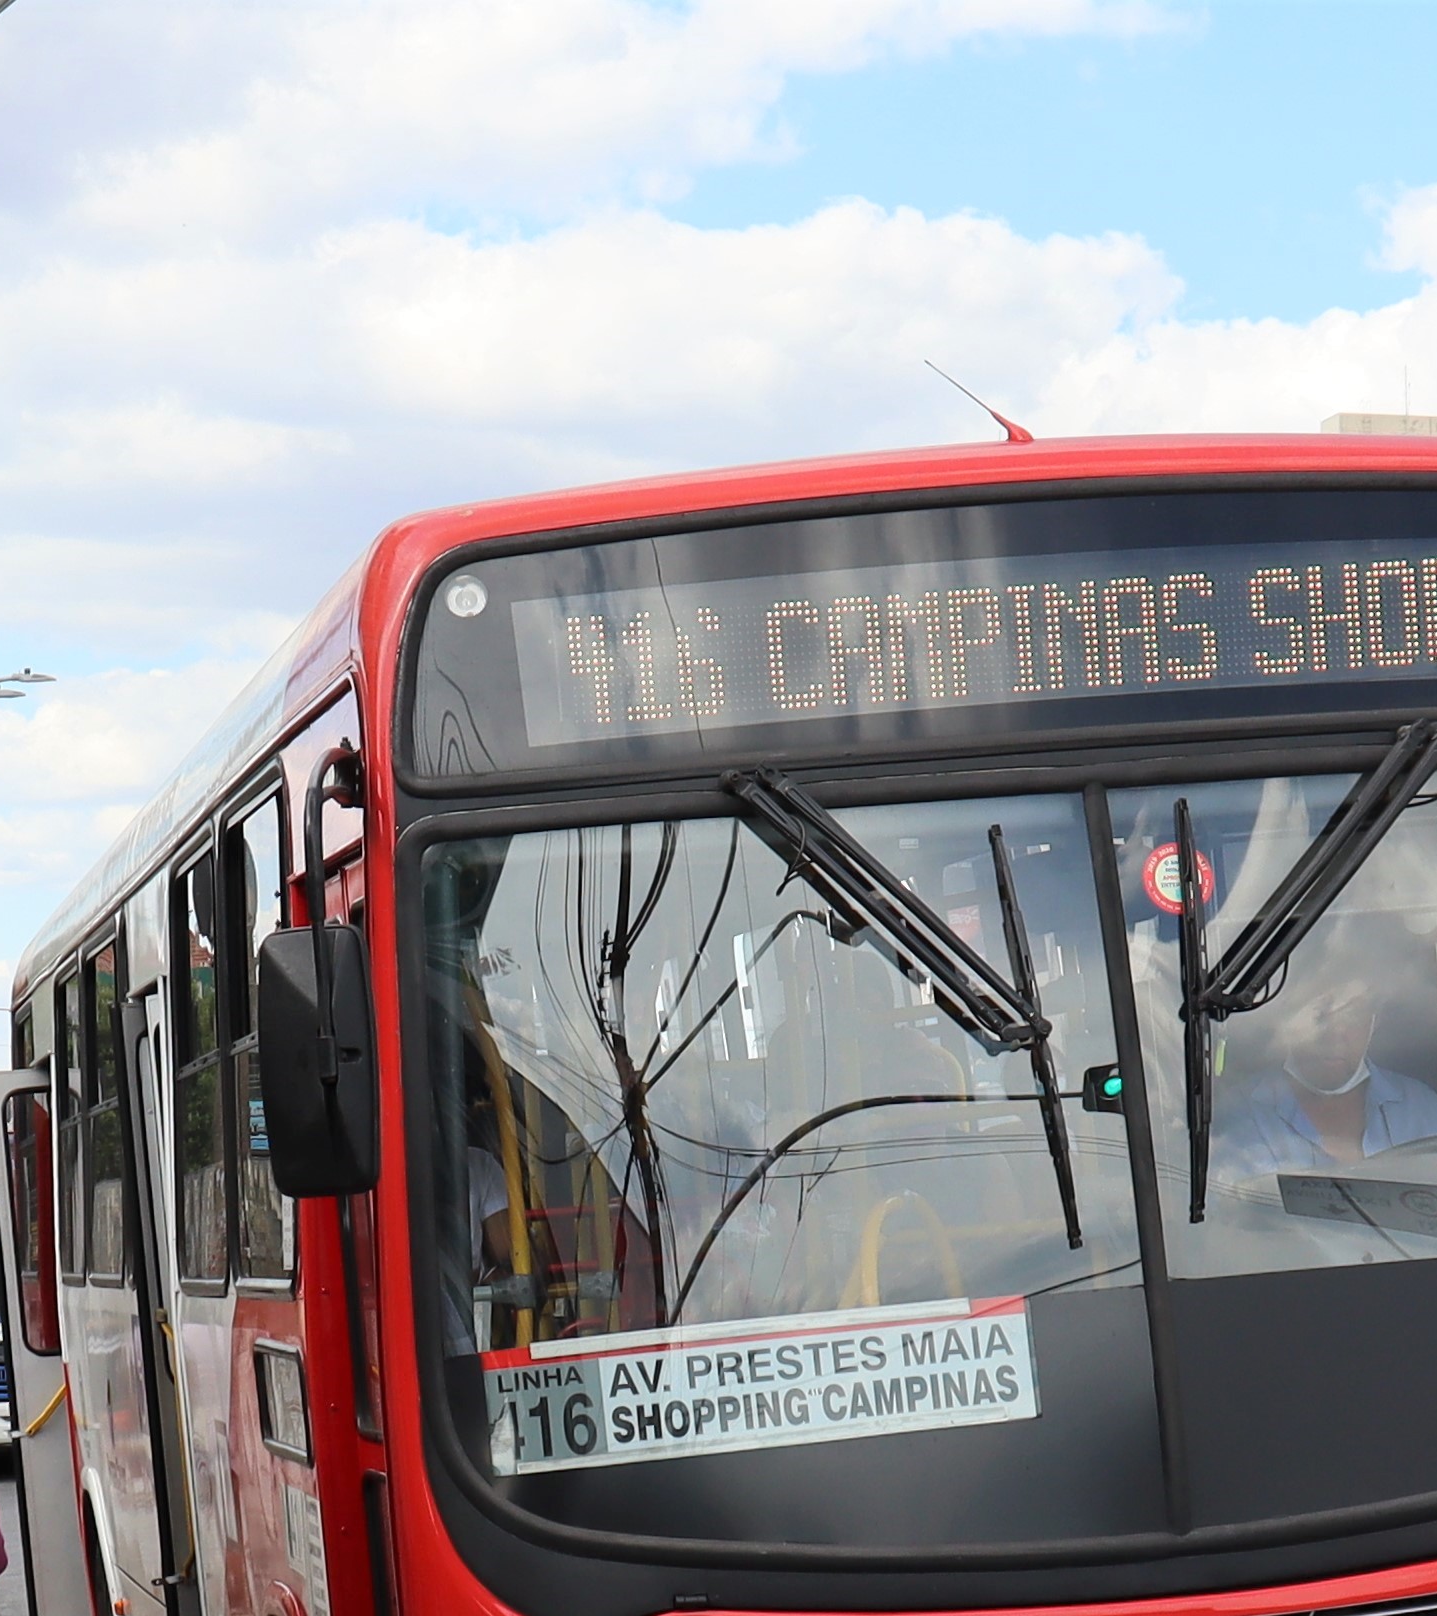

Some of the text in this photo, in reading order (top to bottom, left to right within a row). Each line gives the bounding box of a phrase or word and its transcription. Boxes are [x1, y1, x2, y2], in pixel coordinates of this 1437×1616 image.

[567, 606, 725, 724] 416
[766, 572, 1218, 708] CAMPINAS
[497, 1365, 584, 1394] LINHA
[609, 1323, 1015, 1399] AV. PRESTES MAIA
[611, 1388, 812, 1445] SHOPPING
[820, 1364, 1021, 1418] CAMPINAS
